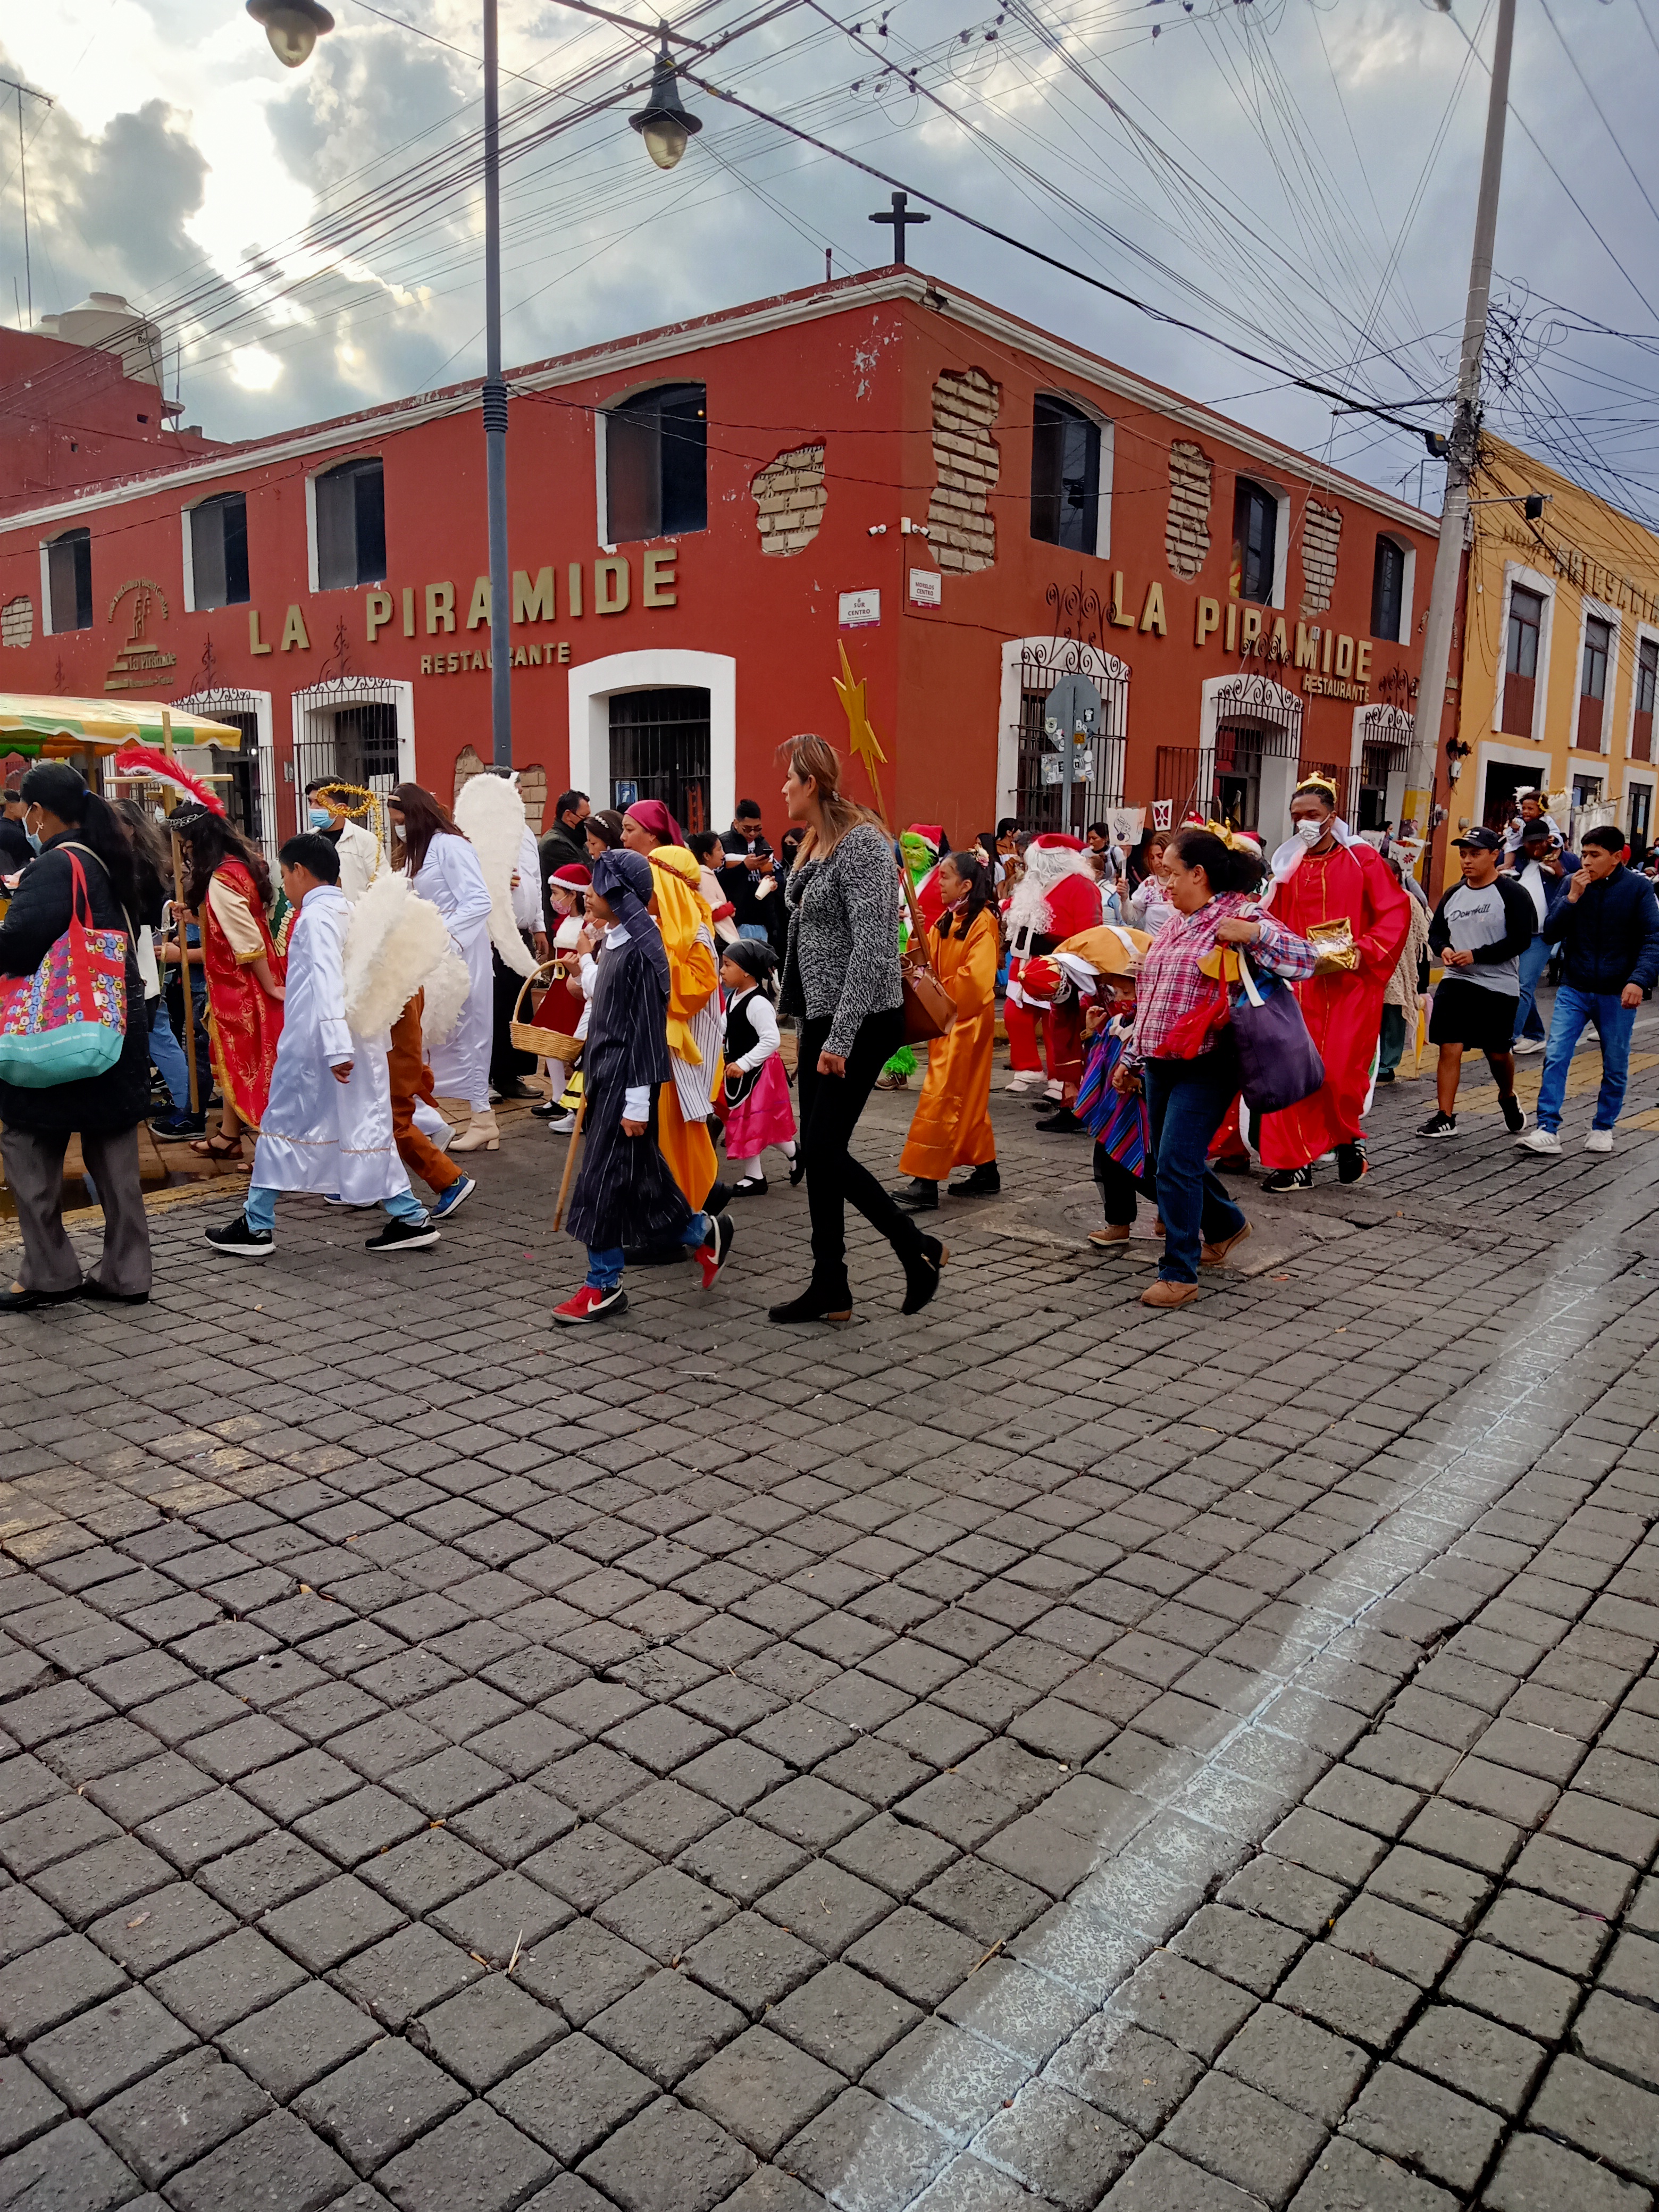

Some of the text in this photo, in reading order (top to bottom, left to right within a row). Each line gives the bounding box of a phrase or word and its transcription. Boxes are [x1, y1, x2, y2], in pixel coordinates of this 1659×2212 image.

[248, 548, 678, 655] LA PIRAMIDE
[915, 582, 934, 590] MORELOS
[1112, 571, 1167, 635] LA
[1195, 594, 1373, 682] PIRAMIDE
[1302, 673, 1370, 702] RESTAURANTE
